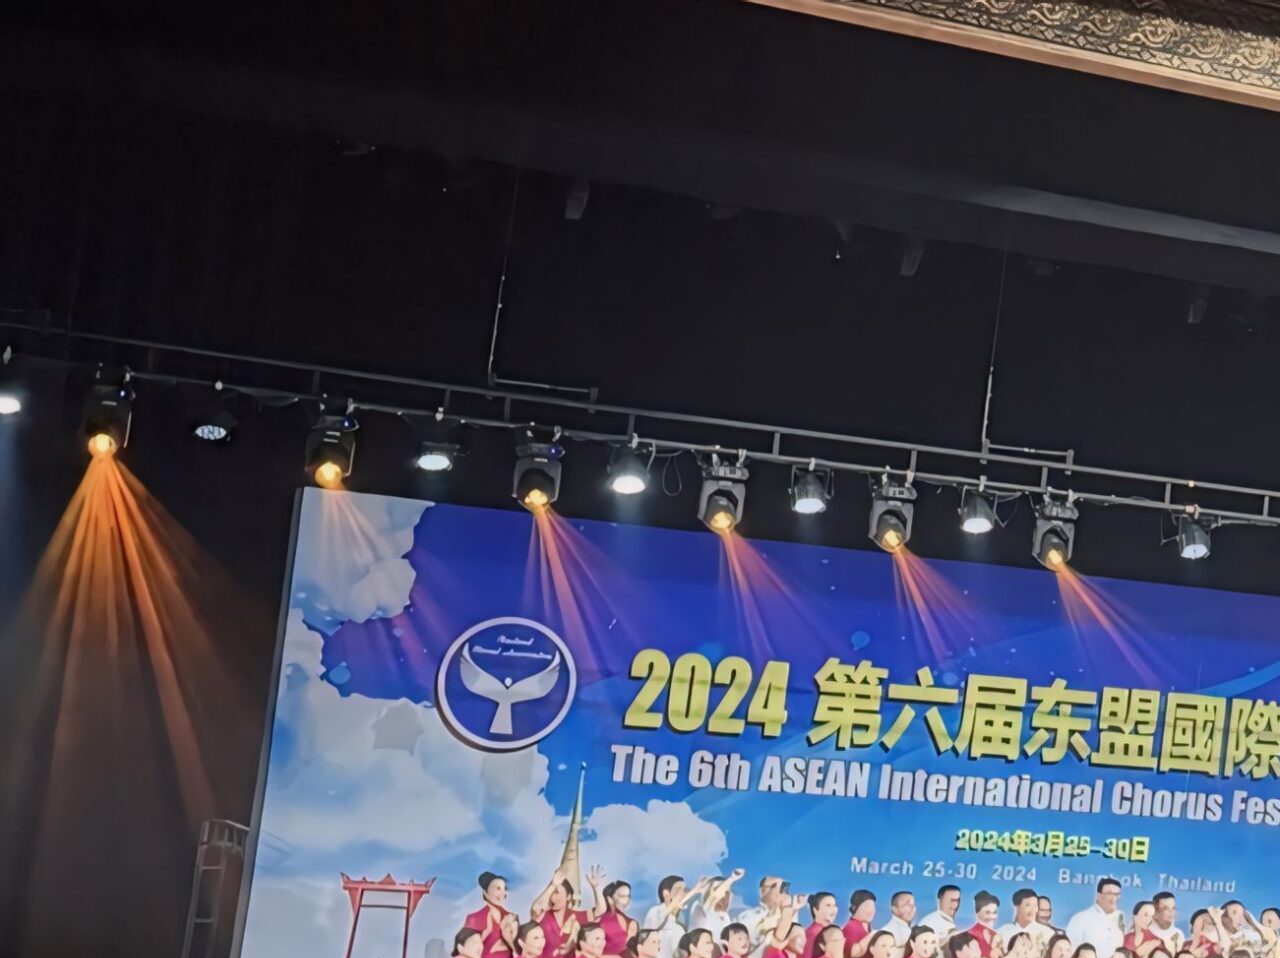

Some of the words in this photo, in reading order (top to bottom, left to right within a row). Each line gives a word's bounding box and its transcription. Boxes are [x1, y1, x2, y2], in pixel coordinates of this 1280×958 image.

[622, 648, 791, 738] 2024
[611, 745, 679, 786] The
[688, 749, 751, 791] 6th
[758, 755, 870, 798] ASEAN
[878, 763, 1102, 814] International
[1111, 780, 1223, 822] Chorus
[851, 858, 914, 876] March
[991, 865, 1037, 881] 2024
[1058, 868, 1142, 888] Banok
[1158, 873, 1236, 893] Thailand
